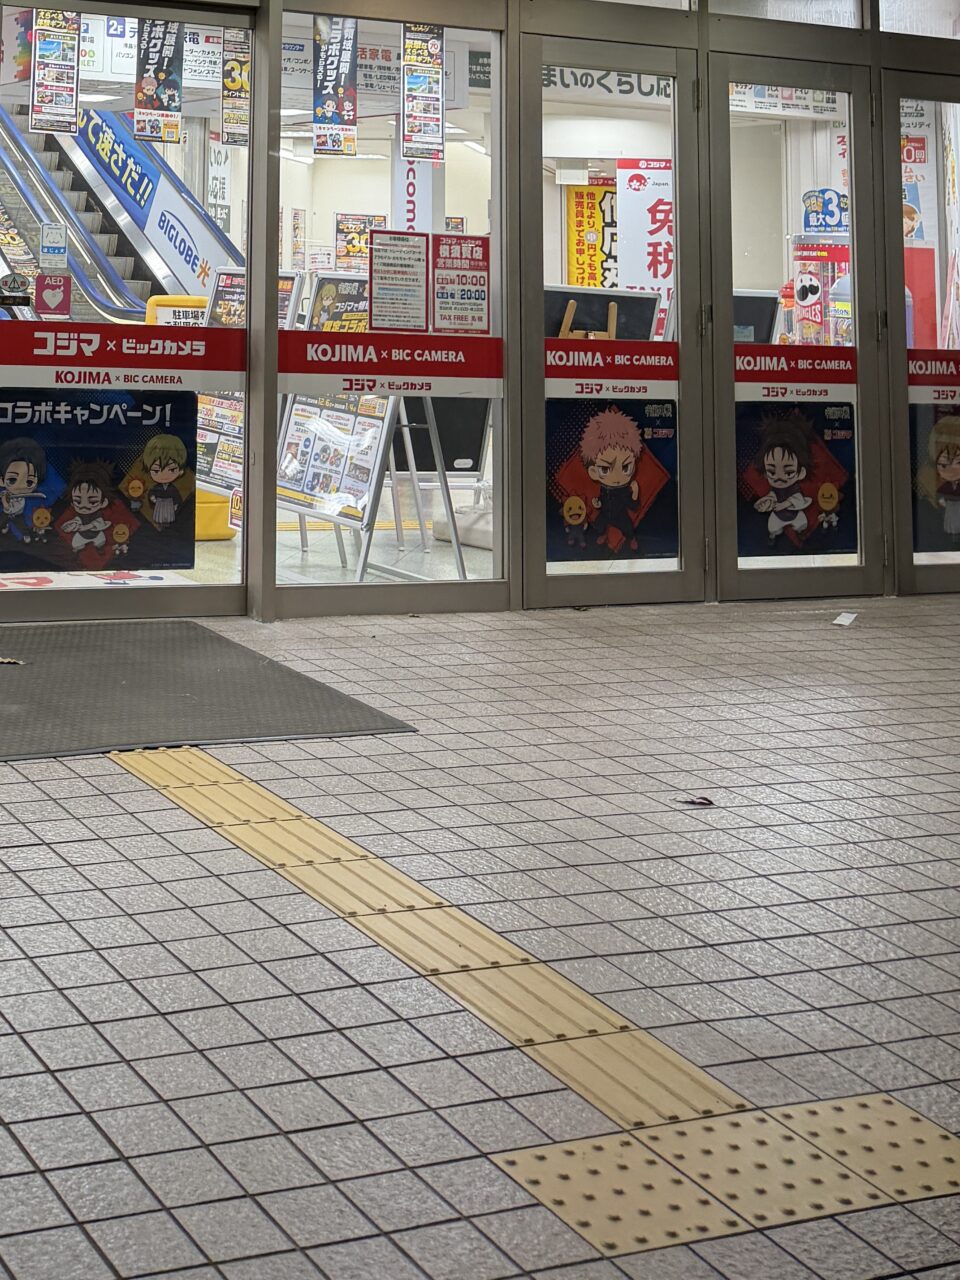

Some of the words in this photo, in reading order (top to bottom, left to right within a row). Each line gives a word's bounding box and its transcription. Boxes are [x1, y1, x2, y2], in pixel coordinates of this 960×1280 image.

[108, 19, 124, 35] 2F
[143, 20, 165, 78] ボグッズ
[157, 209, 200, 273] BIGLOBE
[646, 198, 672, 280] 免税
[44, 276, 65, 285] AED
[456, 274, 486, 287] 10:00
[460, 289, 486, 301] 20:00
[33, 331, 101, 357] コジマ
[122, 338, 206, 357] ビックカメラ
[306, 344, 378, 363] KOJIMA
[392, 349, 411, 361] BIC
[414, 349, 465, 363] CAMERA
[546, 350, 604, 367] KOJIMA
[614, 354, 631, 366] BIC
[633, 354, 674, 366] CAMERA
[735, 355, 788, 371] KOJIMA
[797, 359, 813, 370] BIC
[815, 359, 852, 371] CAMERA
[908, 359, 958, 376] KOJIMA
[54, 370, 112, 385] KOJIMA
[123, 374, 139, 384] BIC
[141, 374, 183, 385] CAMERA
[342, 378, 377, 392] コジマ
[388, 381, 432, 391] ビックカメラ
[575, 383, 603, 394] コジマ
[612, 385, 648, 393] ビックカメラ
[762, 386, 788, 398] コジマ
[795, 388, 828, 397] ビックカメラ
[932, 389, 958, 401] コジマ
